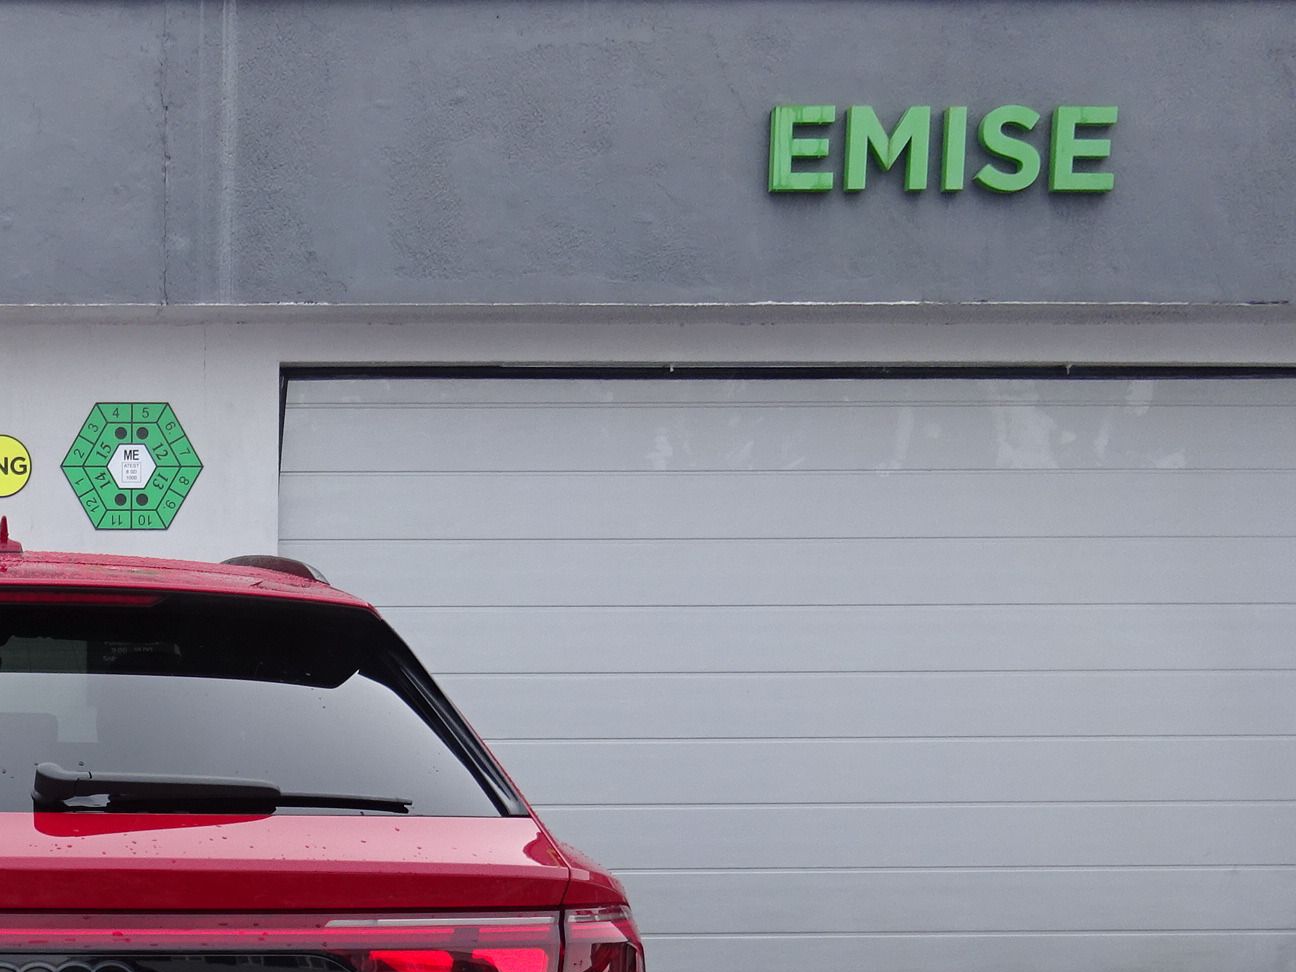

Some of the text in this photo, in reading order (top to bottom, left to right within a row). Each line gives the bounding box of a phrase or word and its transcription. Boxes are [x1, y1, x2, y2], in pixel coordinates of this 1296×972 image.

[768, 104, 1119, 193] EMISE
[112, 407, 120, 418] 4
[142, 407, 149, 418] 5
[88, 422, 99, 433] 3
[74, 448, 85, 459] 2
[96, 441, 112, 459] 15
[124, 449, 139, 460] ME
[152, 443, 168, 461] 12
[179, 448, 190, 456] 7
[75, 477, 84, 486] 1
[95, 472, 111, 489] 14
[153, 473, 169, 490] 13
[179, 476, 189, 486] 8
[86, 497, 100, 513] 12
[111, 515, 122, 526] 11
[138, 514, 152, 526] 10
